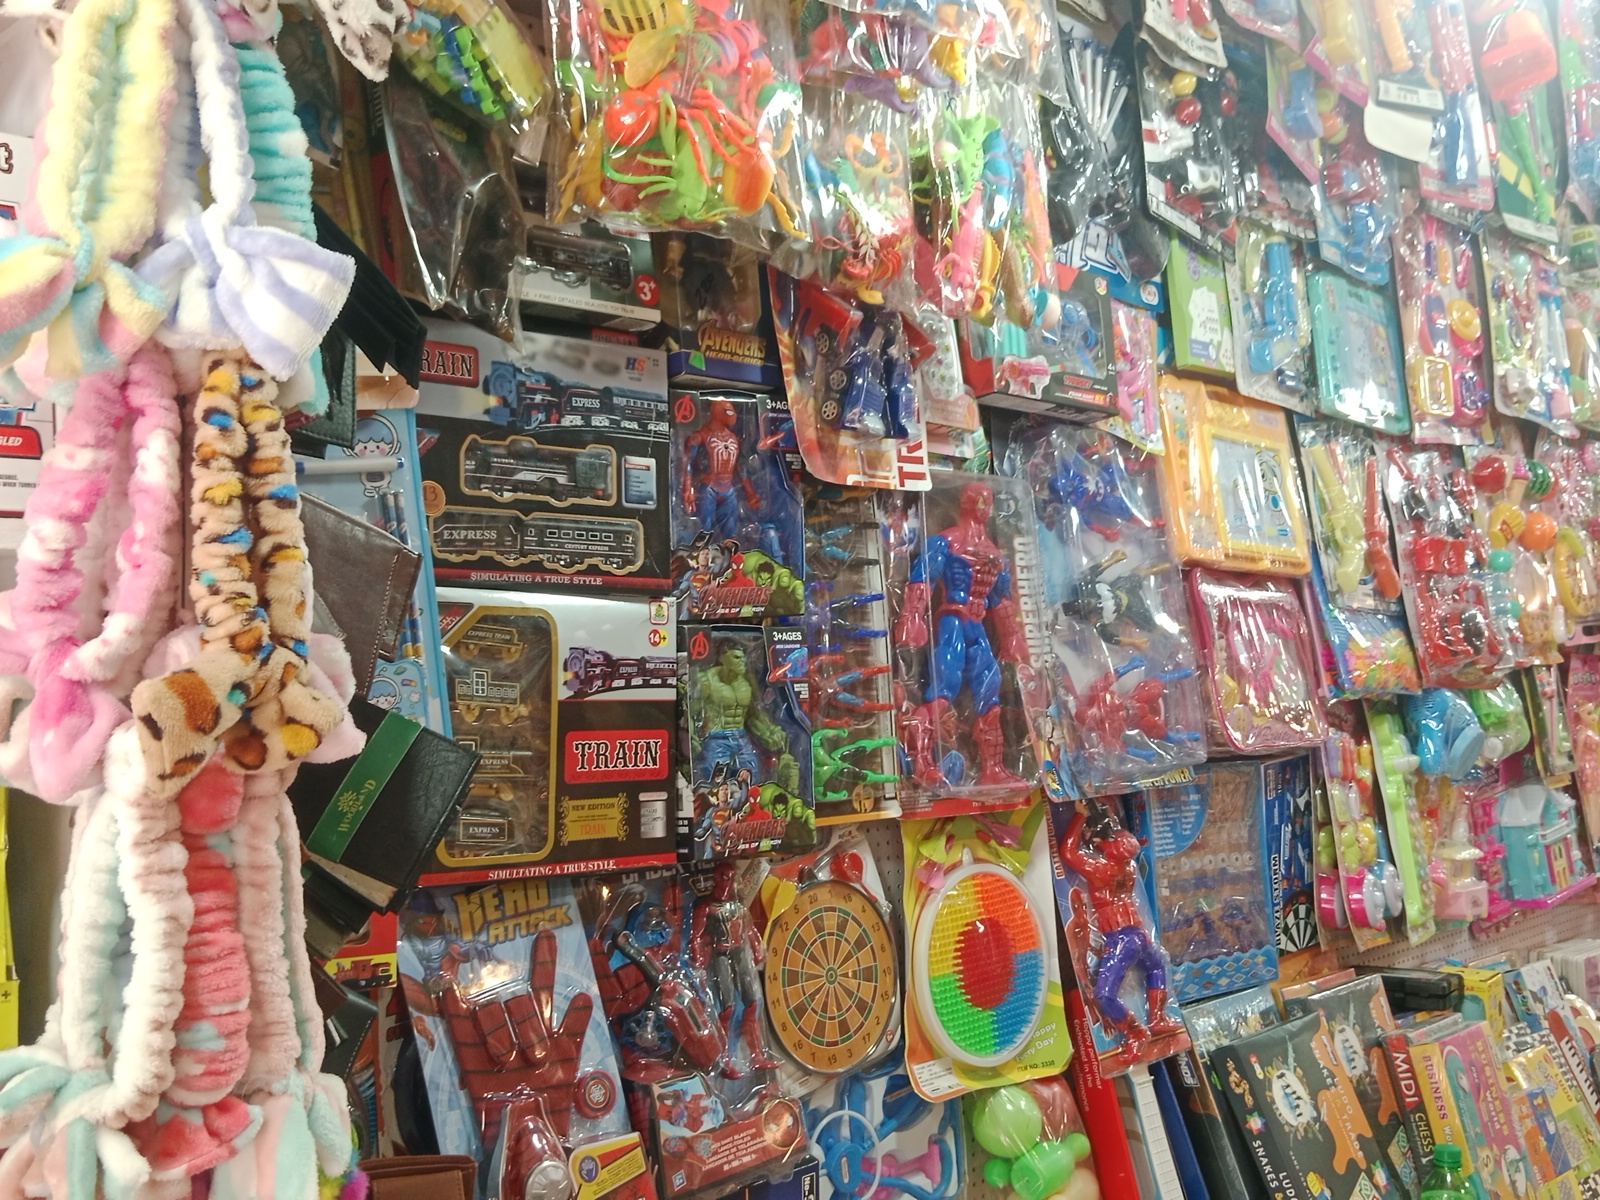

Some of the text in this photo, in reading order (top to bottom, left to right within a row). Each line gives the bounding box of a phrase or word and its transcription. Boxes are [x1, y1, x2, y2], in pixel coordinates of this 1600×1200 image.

[572, 397, 600, 408] EXPRESS
[766, 399, 789, 410] 3+AG
[443, 530, 497, 540] EXPRESS
[470, 572, 532, 583] SIMULATING
[544, 575, 571, 584] TRUE
[573, 577, 603, 585] STYLE
[1013, 536, 1042, 668] SUPERHERO
[467, 630, 493, 639] EXPRESS
[574, 738, 662, 772] TRAIN
[588, 803, 615, 811] EDITION
[581, 824, 607, 835] TRAIN
[554, 866, 561, 875] A
[562, 861, 586, 873] TRUE
[588, 859, 616, 871] STYLE
[1271, 853, 1283, 903] STORM
[807, 893, 819, 905] 20
[828, 889, 833, 899] 1
[843, 893, 853, 904] 18
[794, 904, 800, 915] 5
[861, 905, 866, 914] 4
[780, 921, 790, 934] 12
[871, 922, 881, 934] 13
[772, 947, 778, 958] 9
[880, 943, 886, 953] 6
[882, 965, 892, 978] 10
[767, 971, 778, 985] 14
[880, 992, 890, 1002] 15
[771, 997, 781, 1010] 11
[781, 1021, 788, 1032] 8
[875, 1015, 881, 1026] 2
[861, 1033, 871, 1045] 17
[1073, 1019, 1088, 1062] Enchanted
[792, 1040, 804, 1052] 16
[810, 1052, 816, 1062] 7
[826, 1053, 837, 1066] 19
[846, 1048, 853, 1059] 3
[1015, 1046, 1036, 1063] Every
[1088, 1048, 1103, 1091] performer
[1310, 1040, 1337, 1093] SNAKES
[1392, 1051, 1420, 1102] MIDI
[1422, 1054, 1449, 1120] BUSINESS
[1485, 1089, 1501, 1131] World
[1334, 1077, 1364, 1159] LUDO TRADE
[1415, 1112, 1435, 1153] CHESS
[1252, 1140, 1279, 1188] SNAKES
